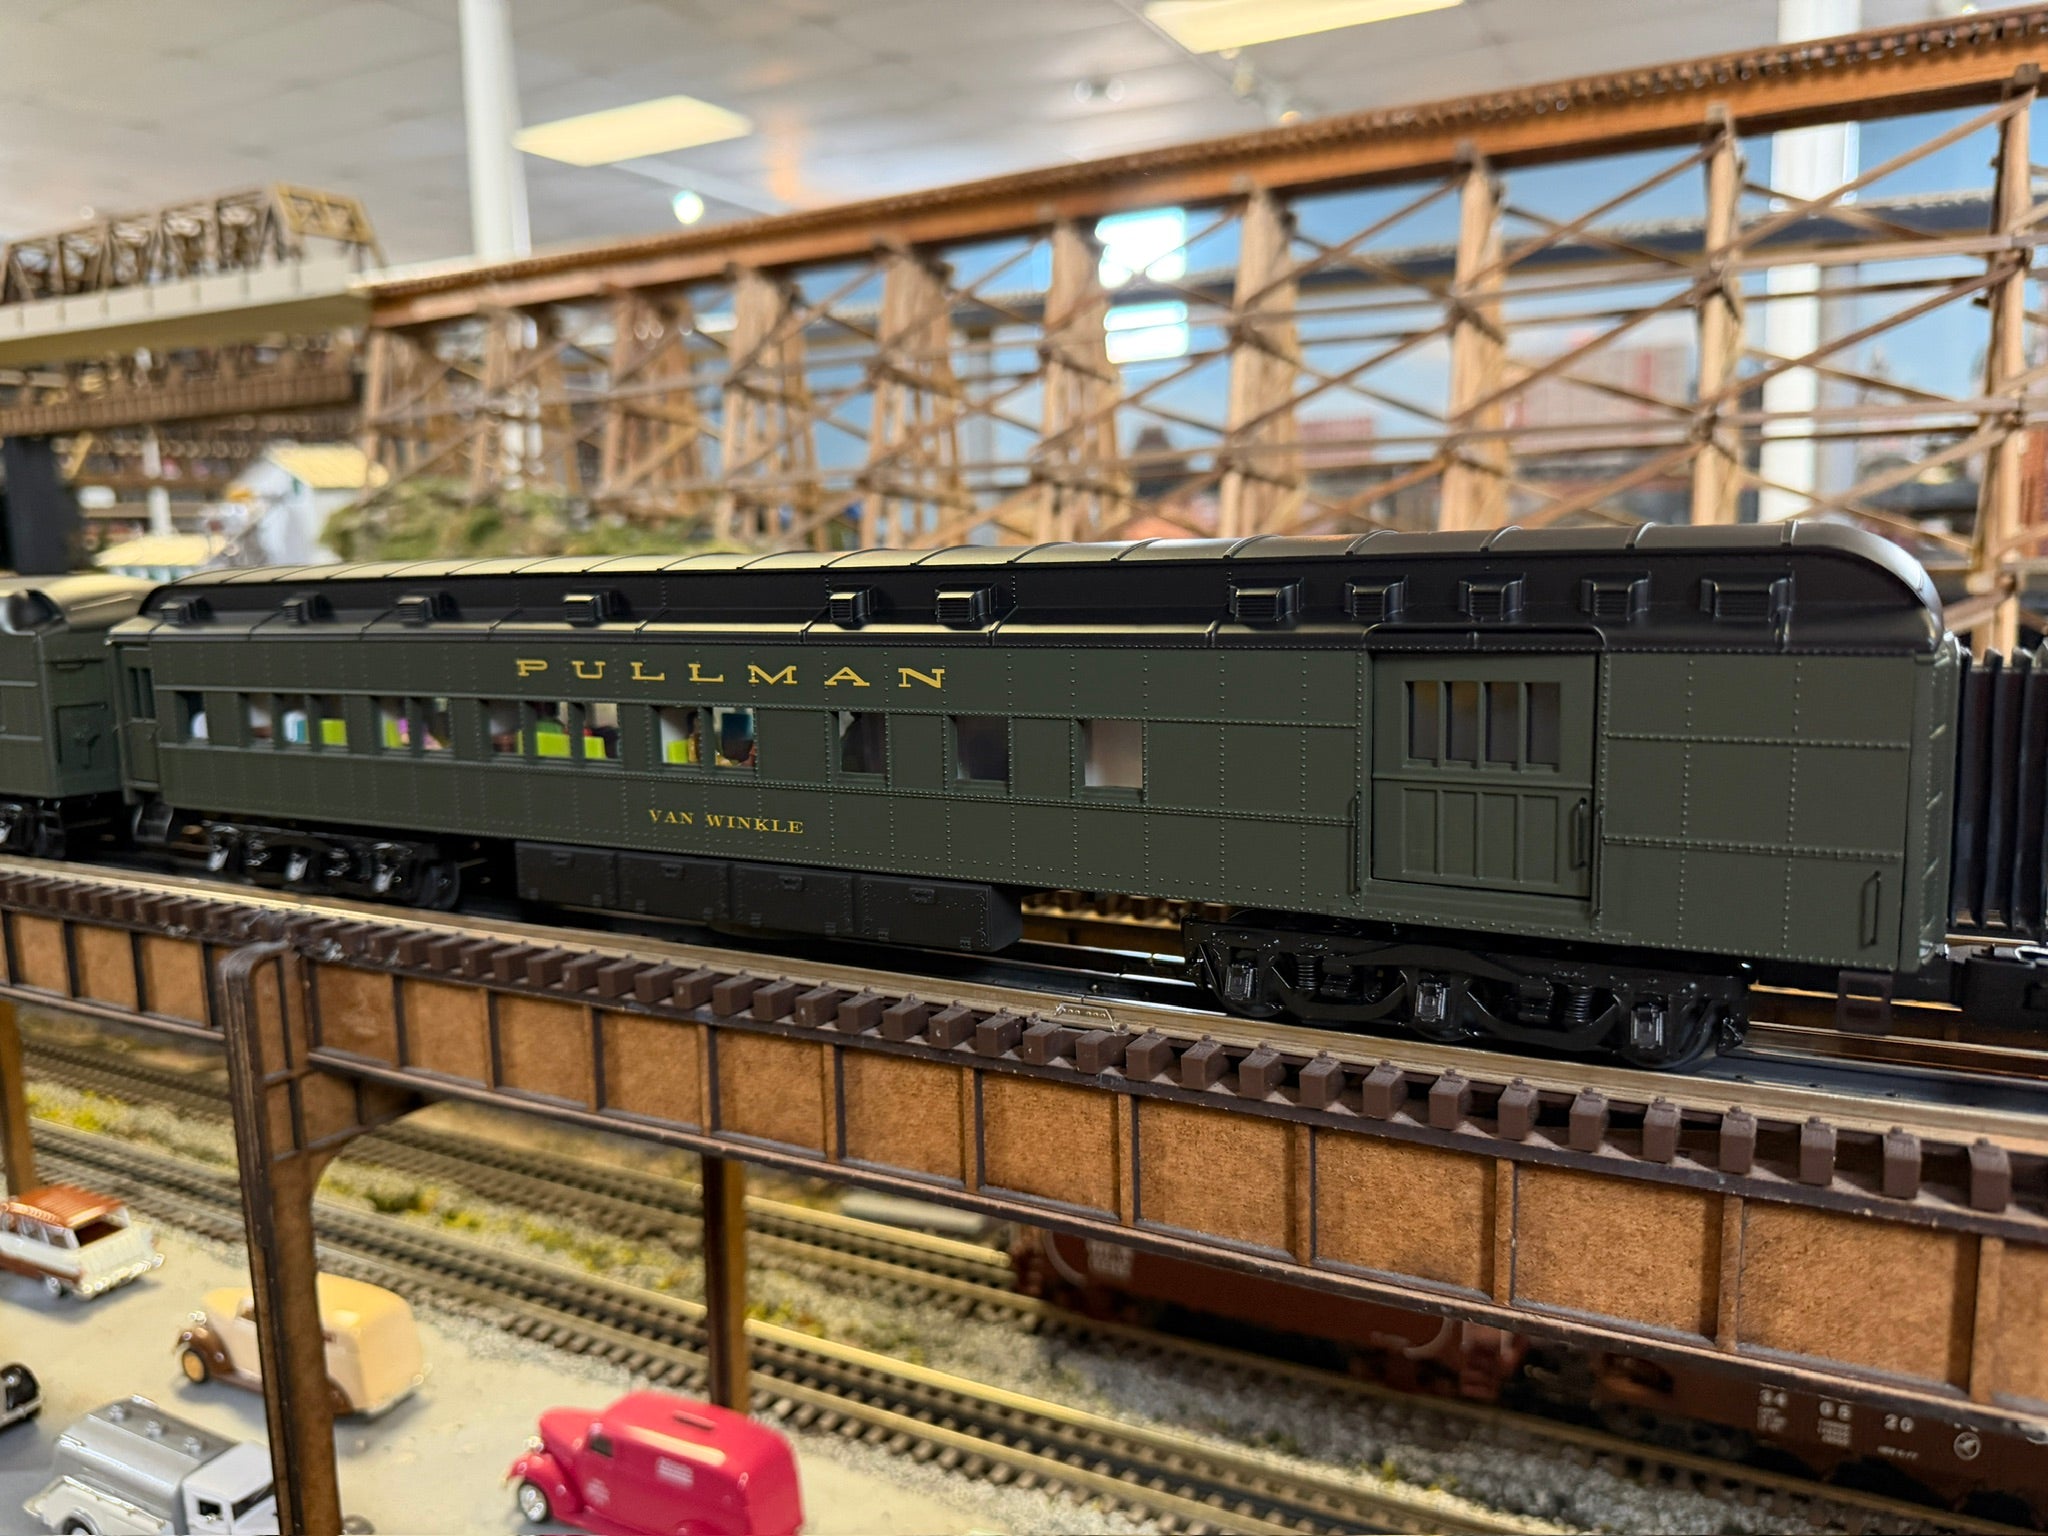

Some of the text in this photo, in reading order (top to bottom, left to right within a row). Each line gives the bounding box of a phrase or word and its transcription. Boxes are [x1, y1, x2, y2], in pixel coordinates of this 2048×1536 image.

[516, 659, 946, 689] PULLMAN
[649, 809, 804, 834] VAN WINKLE
